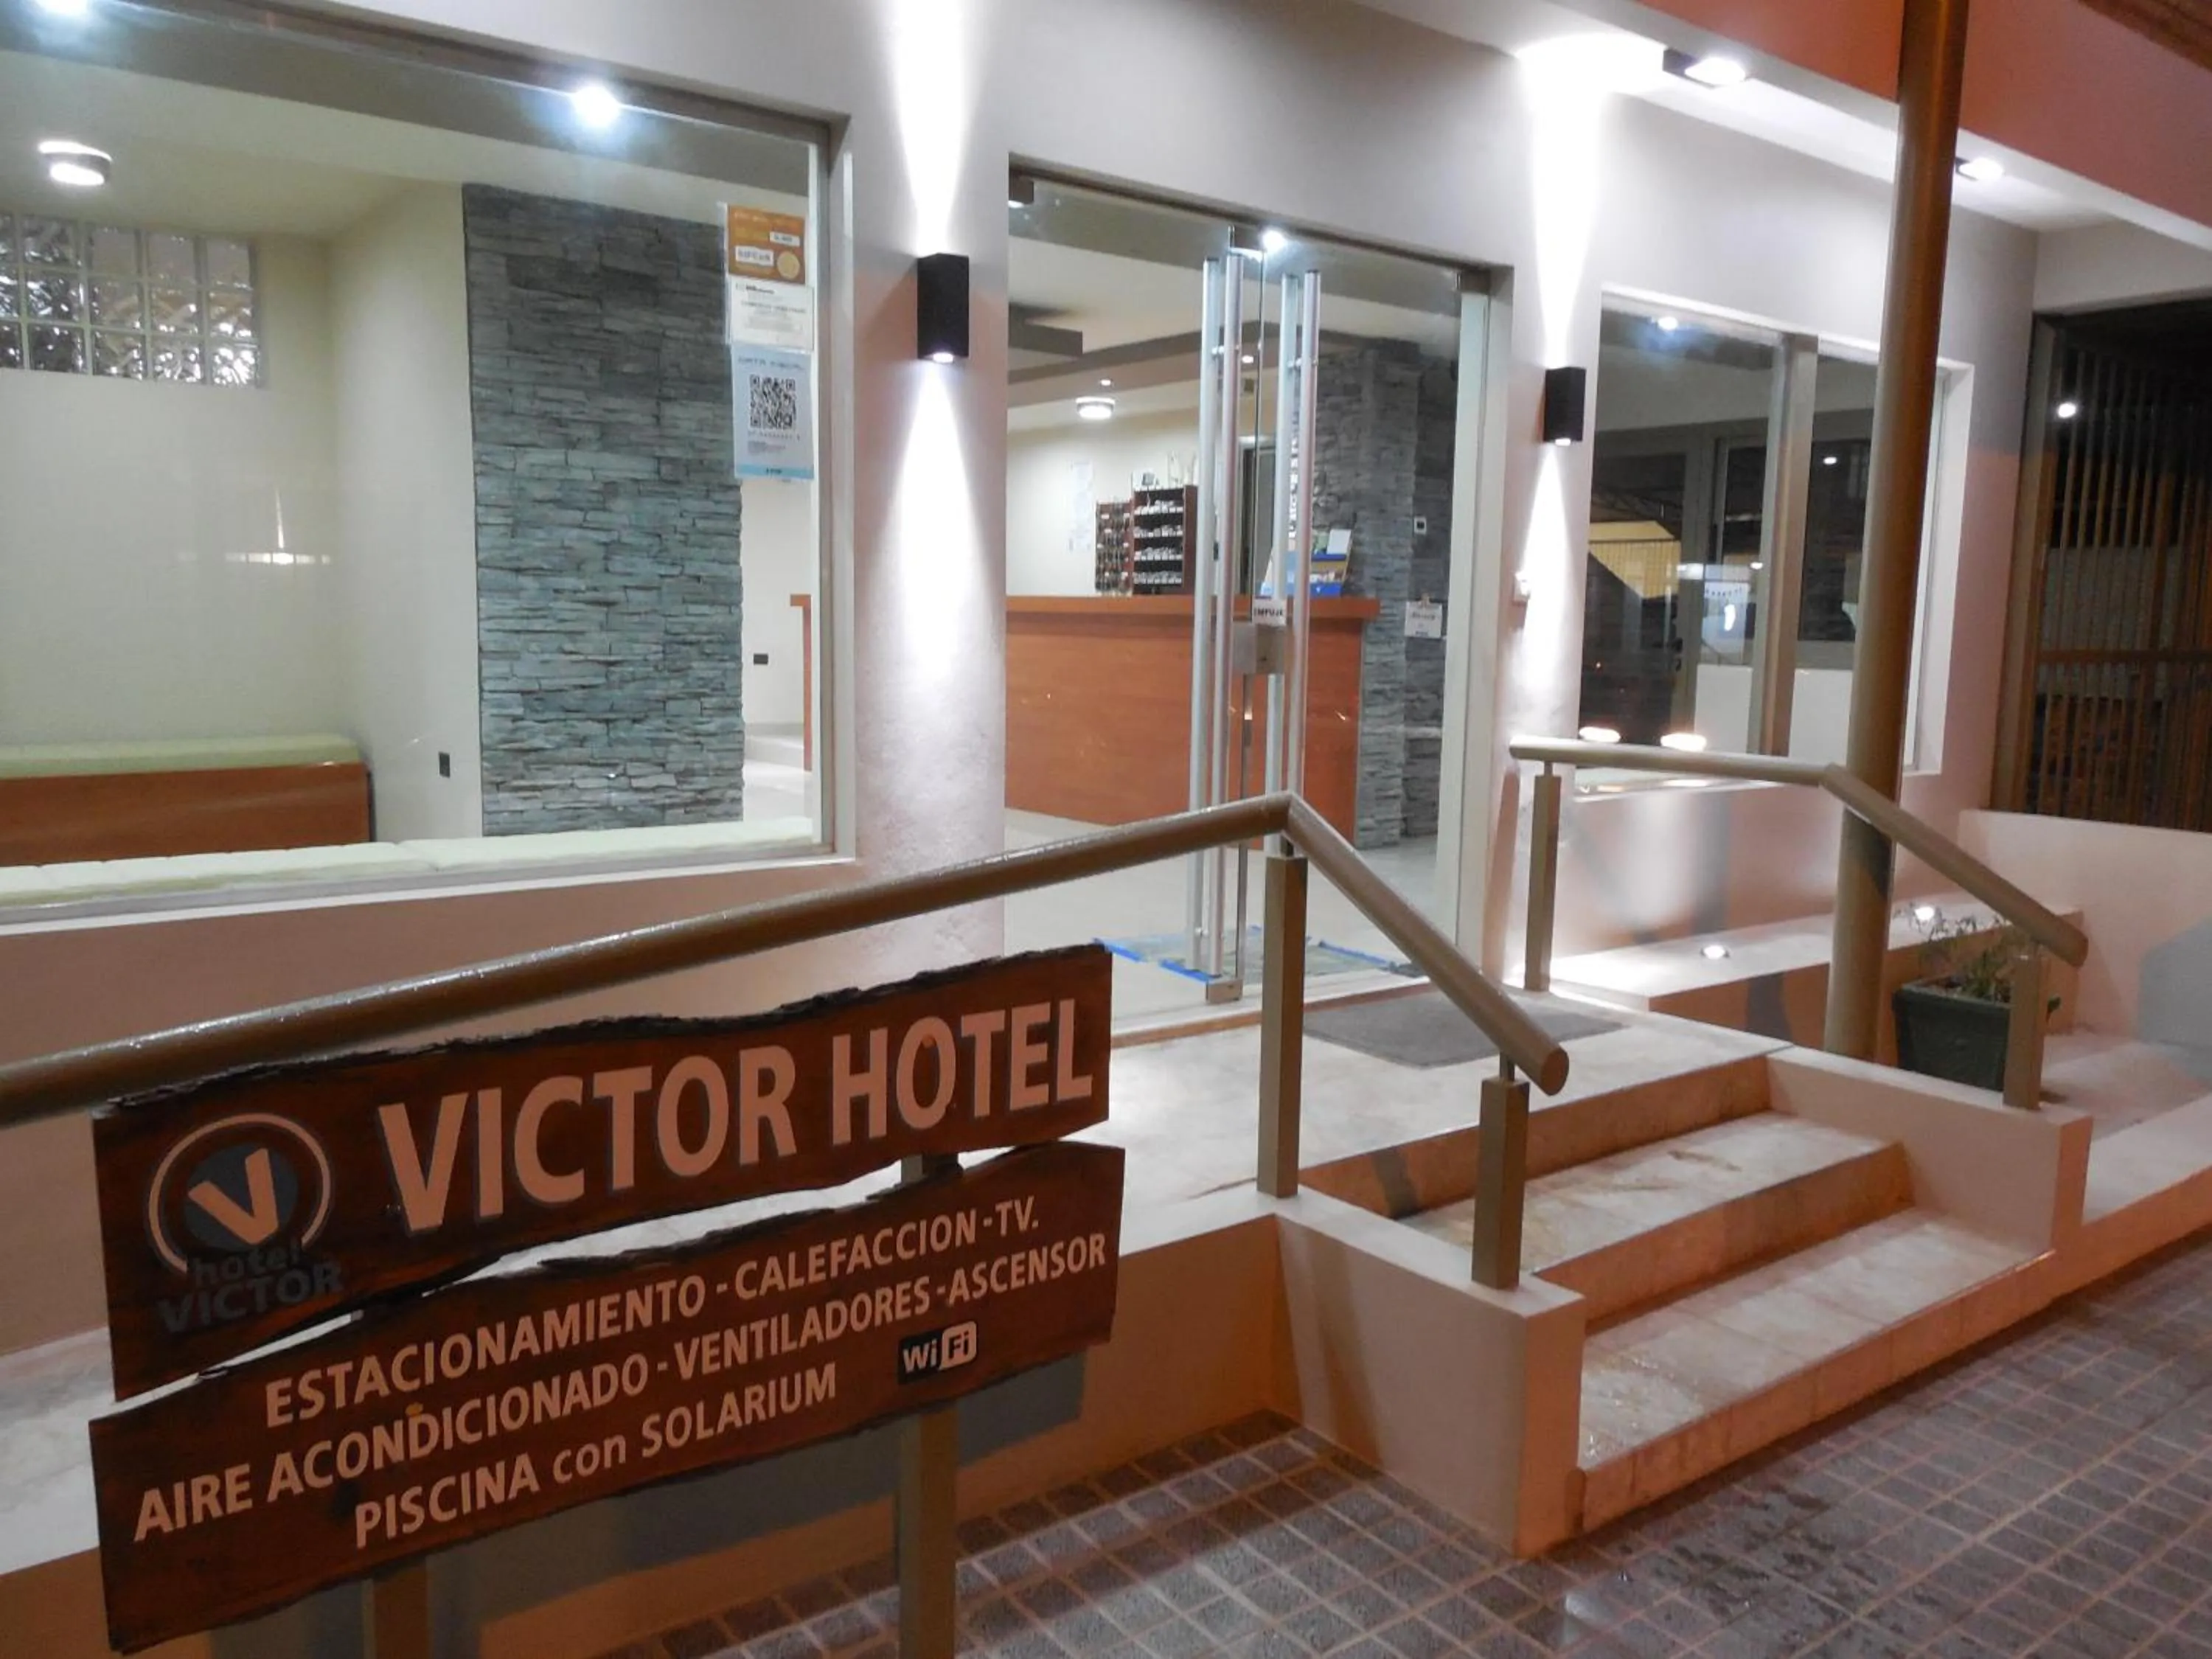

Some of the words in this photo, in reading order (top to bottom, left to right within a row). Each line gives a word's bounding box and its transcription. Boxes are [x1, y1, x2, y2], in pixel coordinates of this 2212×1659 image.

[377, 1046, 798, 1236] VICTOR
[832, 998, 1093, 1145] HOTEL
[156, 1257, 345, 1333] VICTOR
[192, 1236, 302, 1287] hotel
[265, 1279, 706, 1428] ESTACIONAMIENTO
[735, 1208, 977, 1300] CALEFACCION
[133, 1463, 254, 1542] AIRE
[267, 1353, 648, 1502] ACONDICIONADO
[674, 1276, 931, 1380] VENTILADORES
[947, 1233, 1106, 1307] ASCENSOR
[354, 1460, 540, 1548] PISCINA
[553, 1436, 627, 1483] con
[641, 1363, 837, 1457] SOLARIUM
